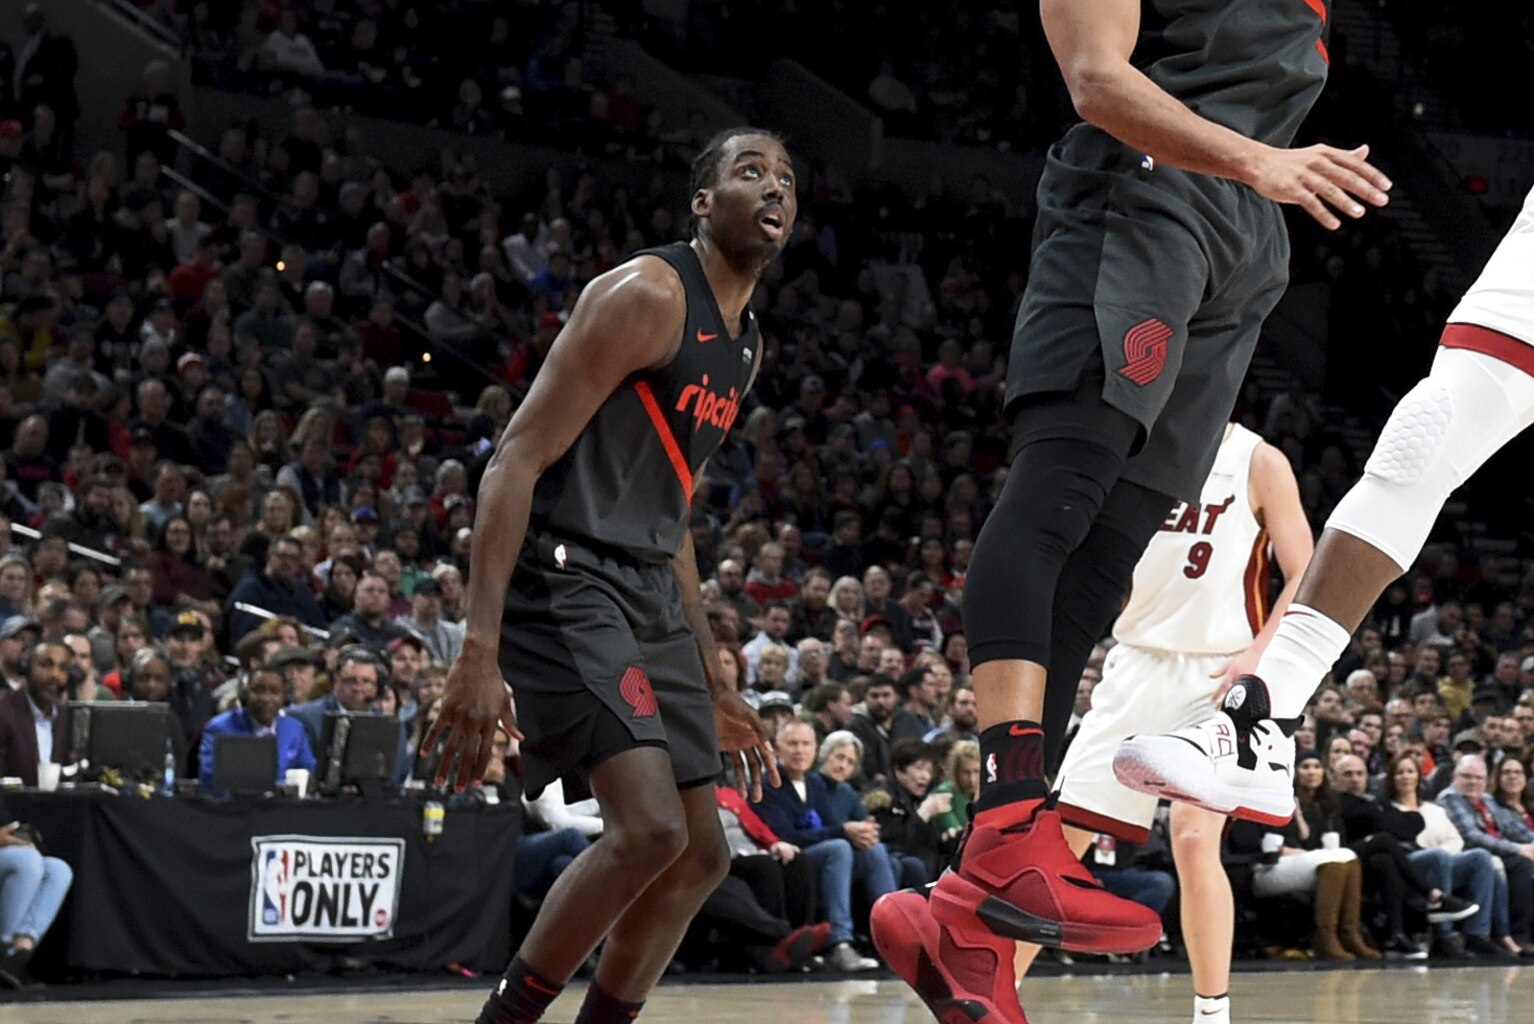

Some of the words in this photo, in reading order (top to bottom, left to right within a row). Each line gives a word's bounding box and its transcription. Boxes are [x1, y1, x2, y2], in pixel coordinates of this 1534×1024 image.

[1183, 541, 1214, 579] 9
[293, 850, 390, 878] PLAYERS
[291, 881, 380, 927] ONLY
